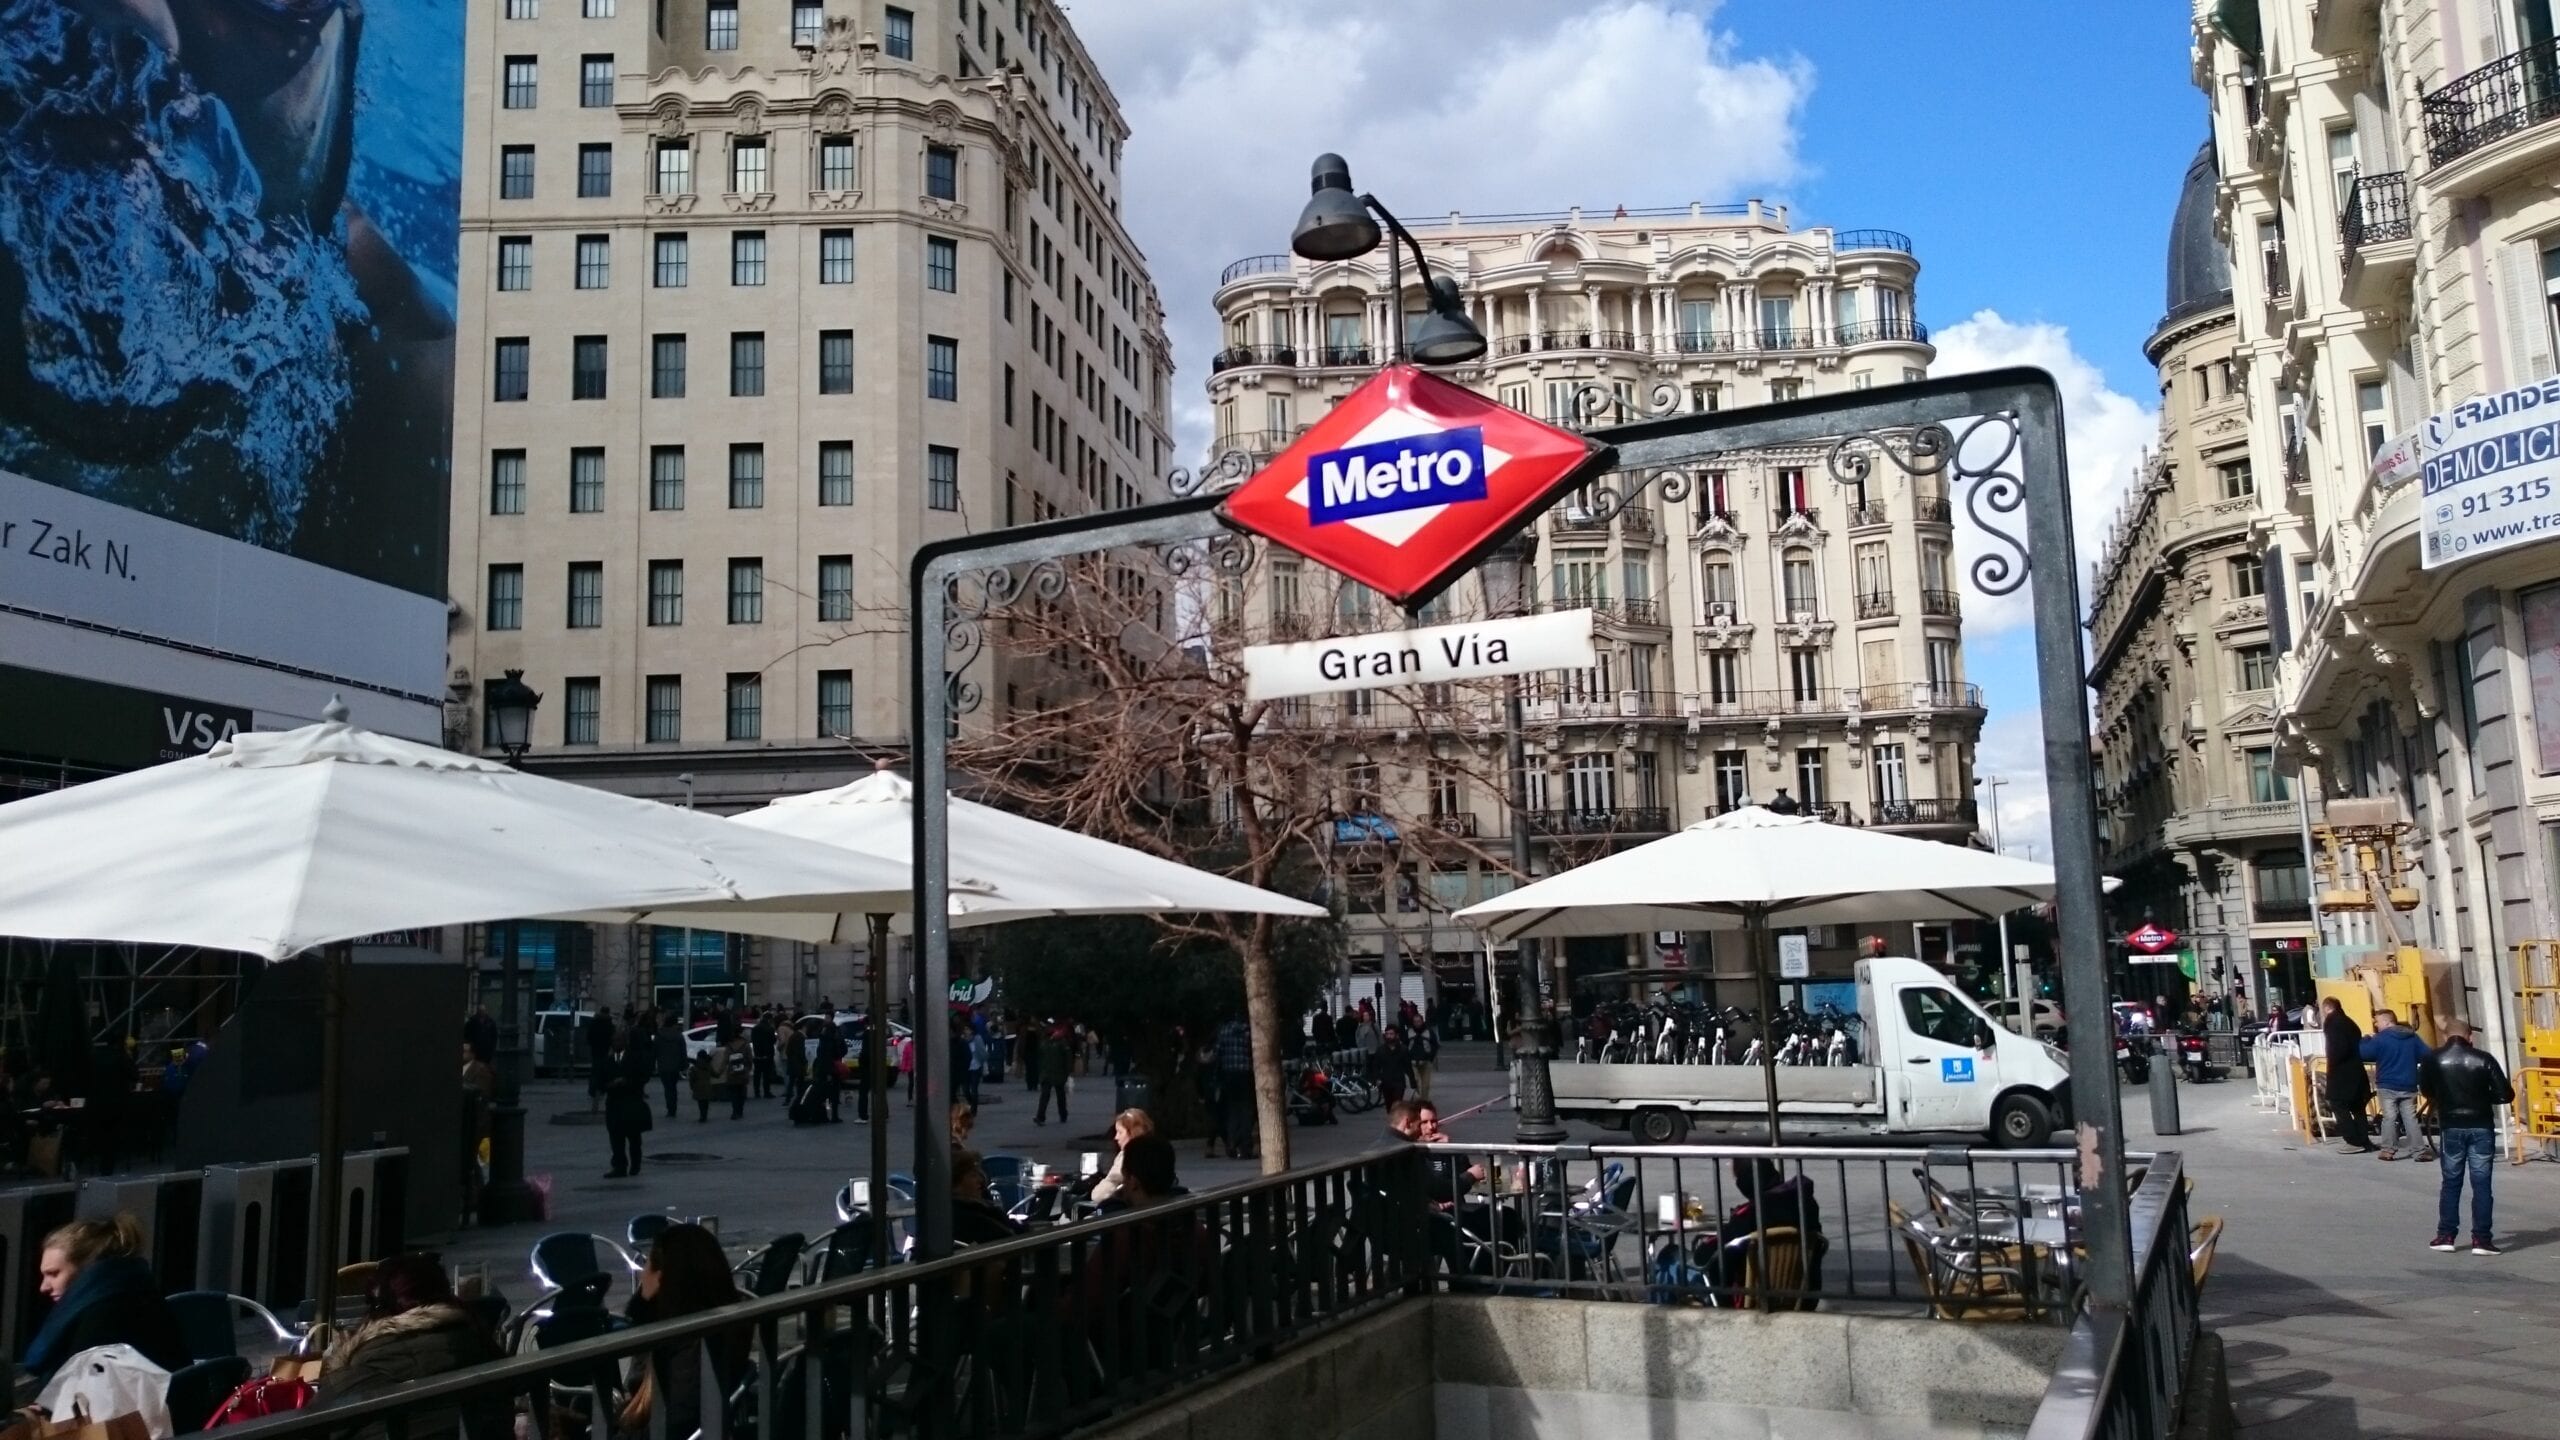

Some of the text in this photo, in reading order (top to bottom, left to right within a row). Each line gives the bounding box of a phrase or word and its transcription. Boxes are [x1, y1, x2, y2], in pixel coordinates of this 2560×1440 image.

[1322, 449, 1473, 508] Metro
[2461, 477, 2551, 518] 91 315
[28, 519, 92, 570] Zak
[105, 539, 136, 581] N.
[1319, 633, 1509, 681] Gran Vía
[163, 706, 241, 750] VSA
